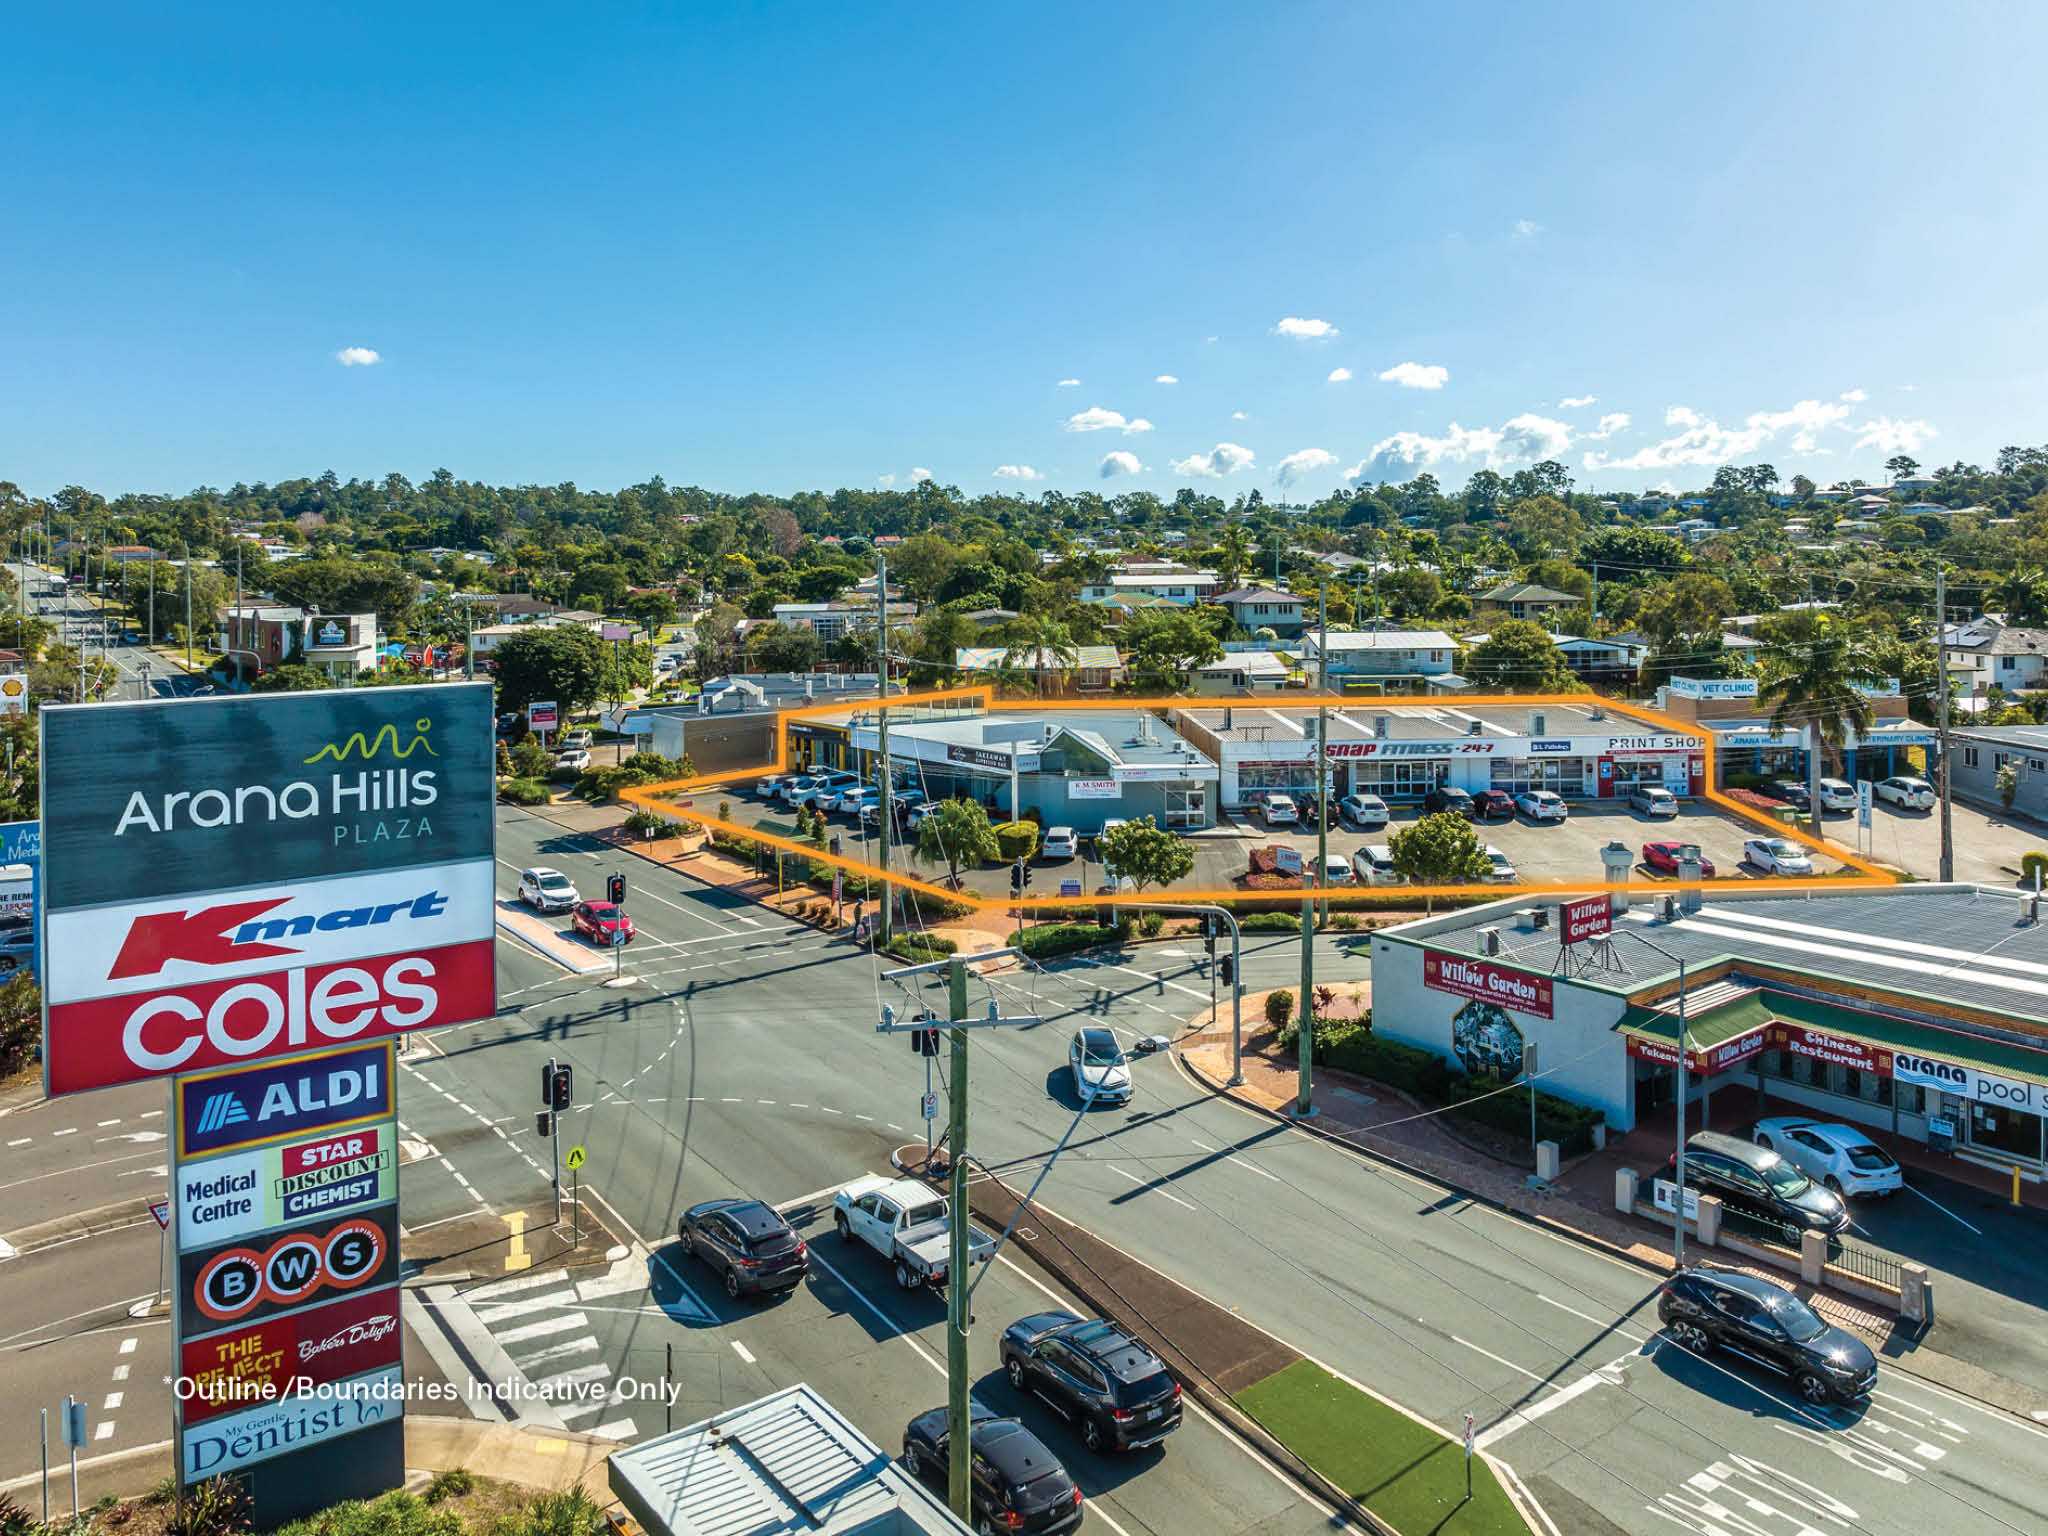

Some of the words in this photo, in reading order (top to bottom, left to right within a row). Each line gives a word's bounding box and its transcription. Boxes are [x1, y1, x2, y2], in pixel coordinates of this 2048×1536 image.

[1702, 684, 1720, 692] VET
[1722, 684, 1754, 692] CLINIC
[1608, 737, 1657, 749] PRINT
[1664, 737, 1706, 748] SHOP
[1734, 736, 1760, 745] ARANA
[1904, 735, 1931, 744] CLINIC
[975, 750, 1008, 761] TAKEAWAY
[114, 779, 320, 837] Arana
[332, 768, 438, 815] Hills
[335, 816, 433, 846] PLAZA
[1571, 903, 1606, 920] Willow
[106, 889, 449, 983] Kmart
[1571, 918, 1608, 937] Garden
[1441, 960, 1484, 987] Willow
[1488, 972, 1537, 1000] Garden
[121, 956, 439, 1071] coles
[1475, 992, 1507, 1007] Restaurant
[1718, 1043, 1741, 1061] Willow
[1741, 1034, 1763, 1053] Garden
[1790, 1040, 1874, 1071] Restaurant
[1805, 1032, 1863, 1056] Chinese
[257, 1063, 379, 1122] ALDI
[1896, 1054, 1967, 1084] arana
[1977, 1079, 2031, 1106] pool
[301, 1138, 363, 1167] STAR
[186, 1169, 256, 1202] Medical
[281, 1154, 385, 1195] DISCOUNT
[289, 1180, 374, 1212] CHEMIST
[192, 1198, 252, 1225] Centre
[216, 1334, 262, 1363] THE
[298, 1338, 345, 1361] Bakers
[349, 1319, 397, 1344] Delight
[189, 1401, 345, 1474] Dentist
[225, 1424, 244, 1441] My
[246, 1411, 287, 1432] Gentle
